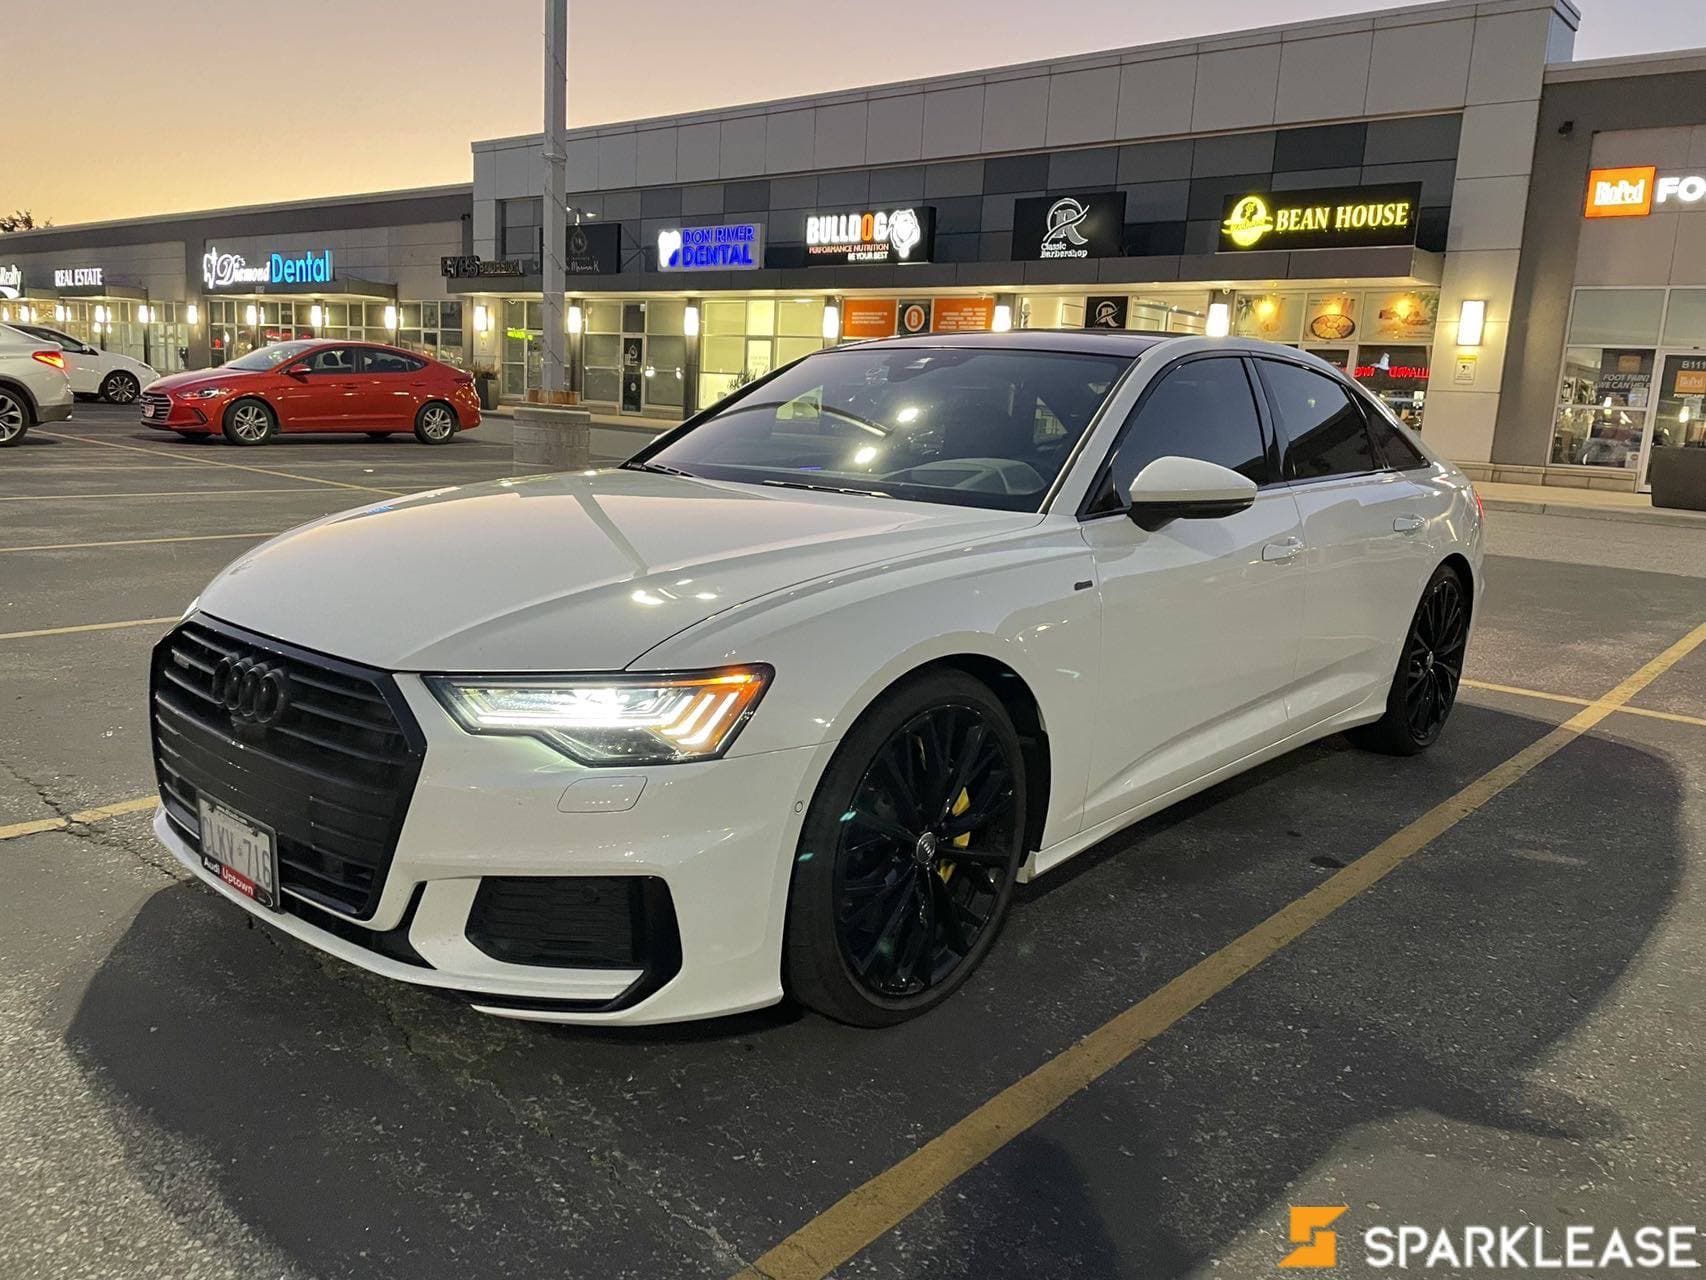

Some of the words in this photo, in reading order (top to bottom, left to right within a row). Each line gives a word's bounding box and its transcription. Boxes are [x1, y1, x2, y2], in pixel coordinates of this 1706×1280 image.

[1275, 206, 1330, 232] BEAN
[1335, 203, 1409, 229] HOUSE
[683, 229, 712, 245] DON
[716, 226, 754, 243] RIVER
[806, 211, 888, 244] BULLDOG
[682, 244, 753, 267] DENTAL
[809, 244, 853, 254] PERFORMANCE
[853, 243, 889, 252] NUTRITION
[856, 252, 872, 260] YOUR
[873, 251, 888, 259] BEST
[1040, 250, 1088, 258] Barbershop
[1041, 242, 1067, 250] Classic
[271, 250, 330, 283] Dental
[55, 269, 73, 286] REAL
[74, 268, 102, 286] ESTATE
[204, 857, 220, 875] Audi
[222, 866, 254, 897] Uptown
